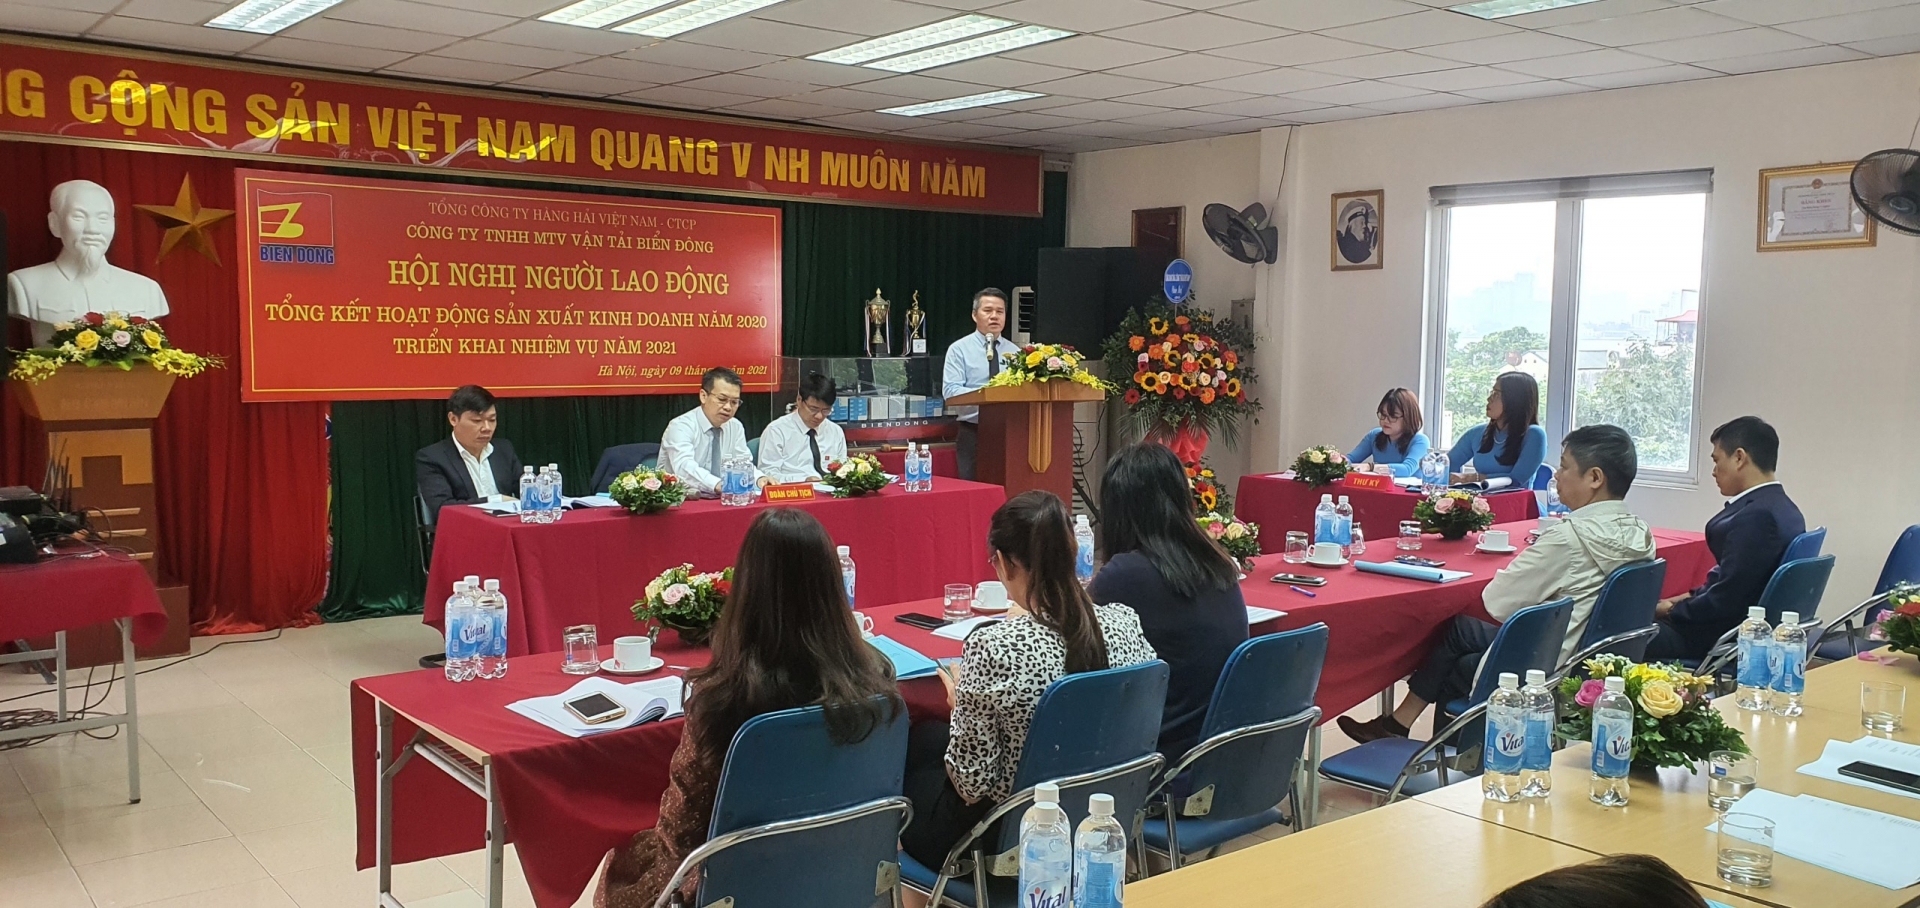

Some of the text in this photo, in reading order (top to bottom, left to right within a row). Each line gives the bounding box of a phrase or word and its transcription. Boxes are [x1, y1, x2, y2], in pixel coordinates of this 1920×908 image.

[0, 68, 46, 118] G
[69, 69, 227, 136] CỘNG
[245, 81, 350, 146] SẢN
[366, 102, 463, 160] VIỆT
[477, 116, 576, 164] NAM
[590, 127, 719, 176] QUANG
[820, 148, 910, 192] MUÔN
[920, 157, 987, 198] NĂM
[428, 197, 468, 216] TỔNG
[471, 202, 510, 219] CÔNG
[514, 207, 530, 219] TY
[533, 205, 570, 223] HÀNG
[573, 208, 596, 225] HẢI
[599, 211, 628, 229] VIỆT
[630, 214, 658, 229] NAM
[667, 217, 697, 231] CTCP
[406, 221, 715, 254] CÔNG TY TNHH MTV VẬN TẢI BIỂN ĐÔNG
[259, 245, 335, 266] BIEN DONG
[387, 252, 730, 300] HỘI NGHỊ NGƯỜI LAO ĐỘNG
[265, 292, 768, 329] TỔNG KẾT HOẠT ĐỘNG SẢN XUẤT KINH DOANH NĂM 2020
[393, 327, 678, 358] TRIỂN KHAI NHIỆM VỤ NĂM 2021
[597, 365, 613, 376] Hà
[616, 365, 637, 379] Nội,
[640, 366, 667, 379] ngày
[669, 366, 682, 376] 09
[729, 365, 745, 375] ăm
[747, 365, 768, 375] 2021
[1353, 477, 1369, 486] THƯ
[1501, 732, 1525, 752] Vita
